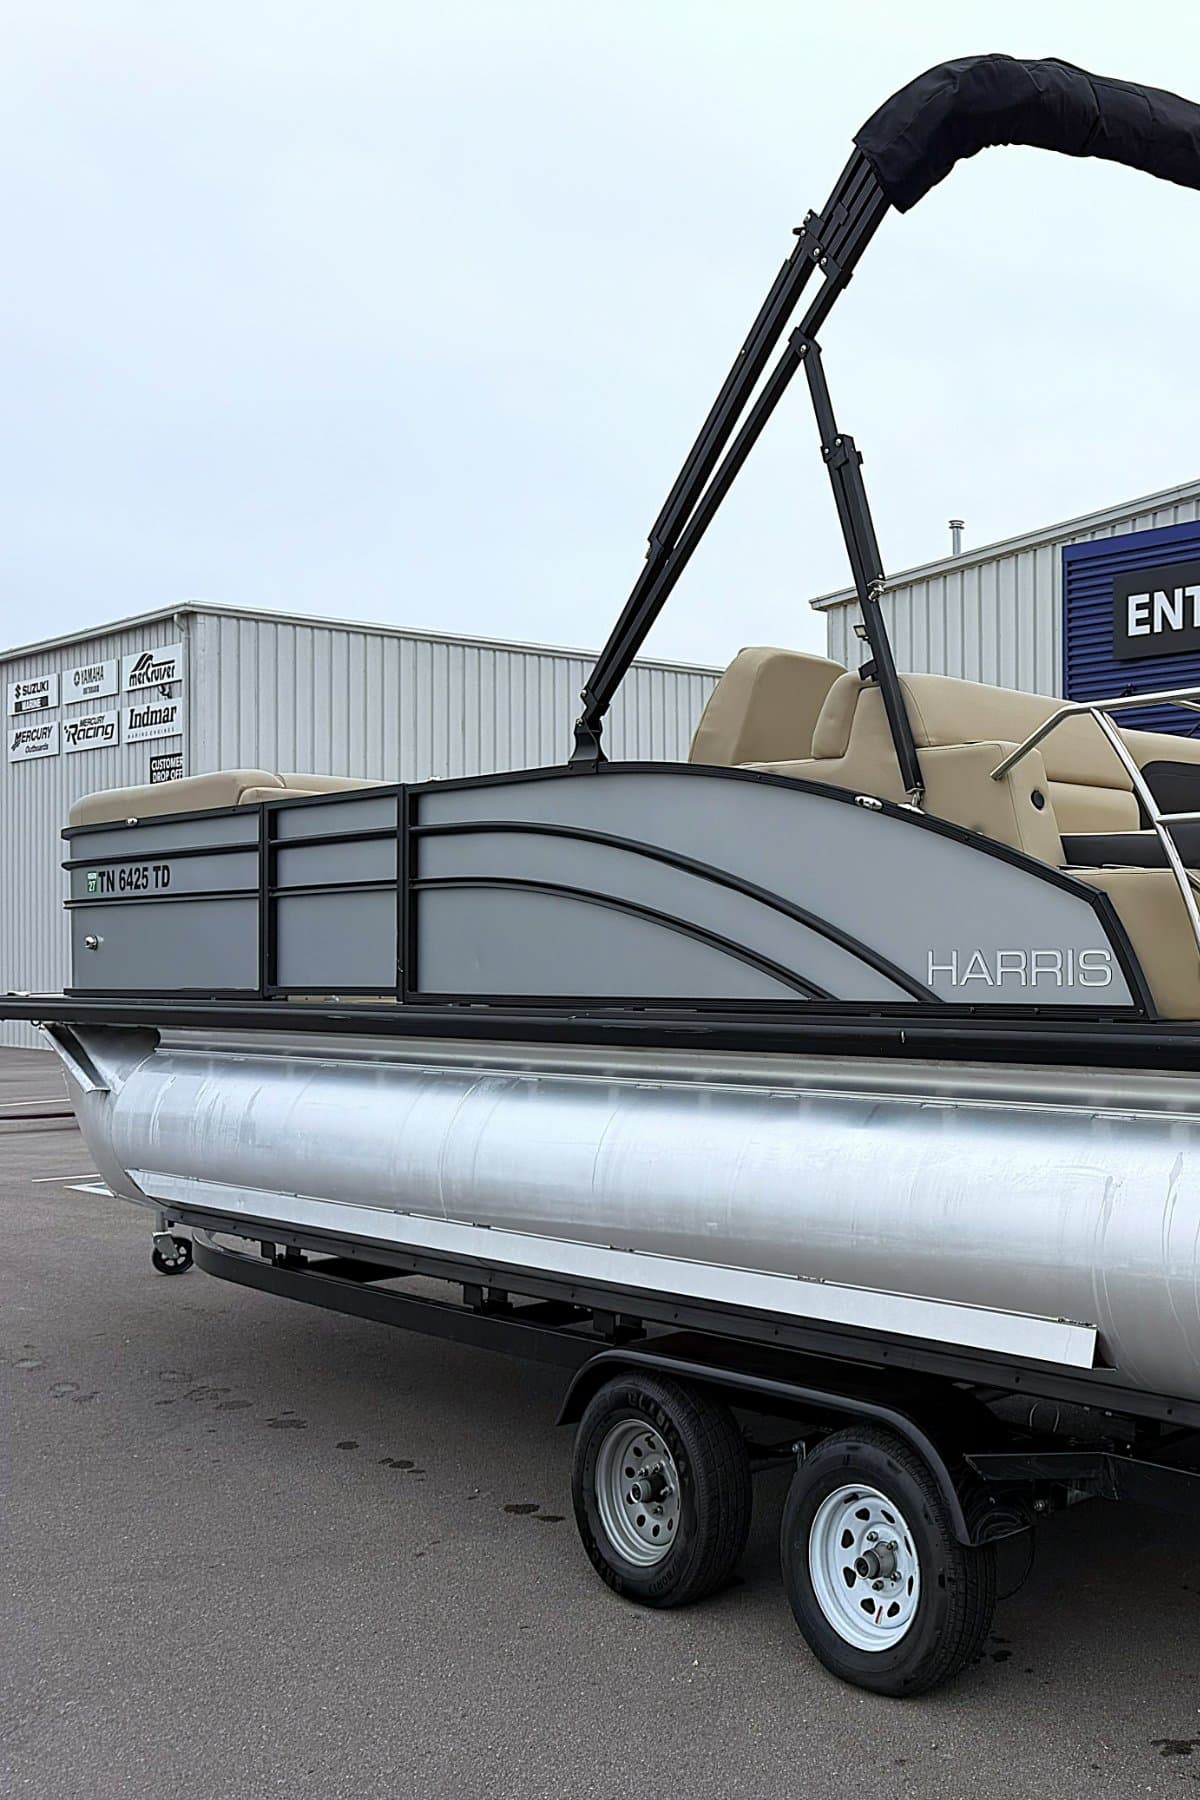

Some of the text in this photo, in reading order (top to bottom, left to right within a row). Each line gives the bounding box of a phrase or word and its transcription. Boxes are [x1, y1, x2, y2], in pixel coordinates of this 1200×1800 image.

[81, 665, 104, 685] YAMAHA
[22, 680, 49, 696] SUZUKI
[128, 705, 177, 730] Indmar
[14, 725, 53, 744] MERCURY
[66, 723, 115, 746] Racing
[98, 864, 170, 893] TN 6425 TD
[927, 948, 1113, 988] HARRIS
